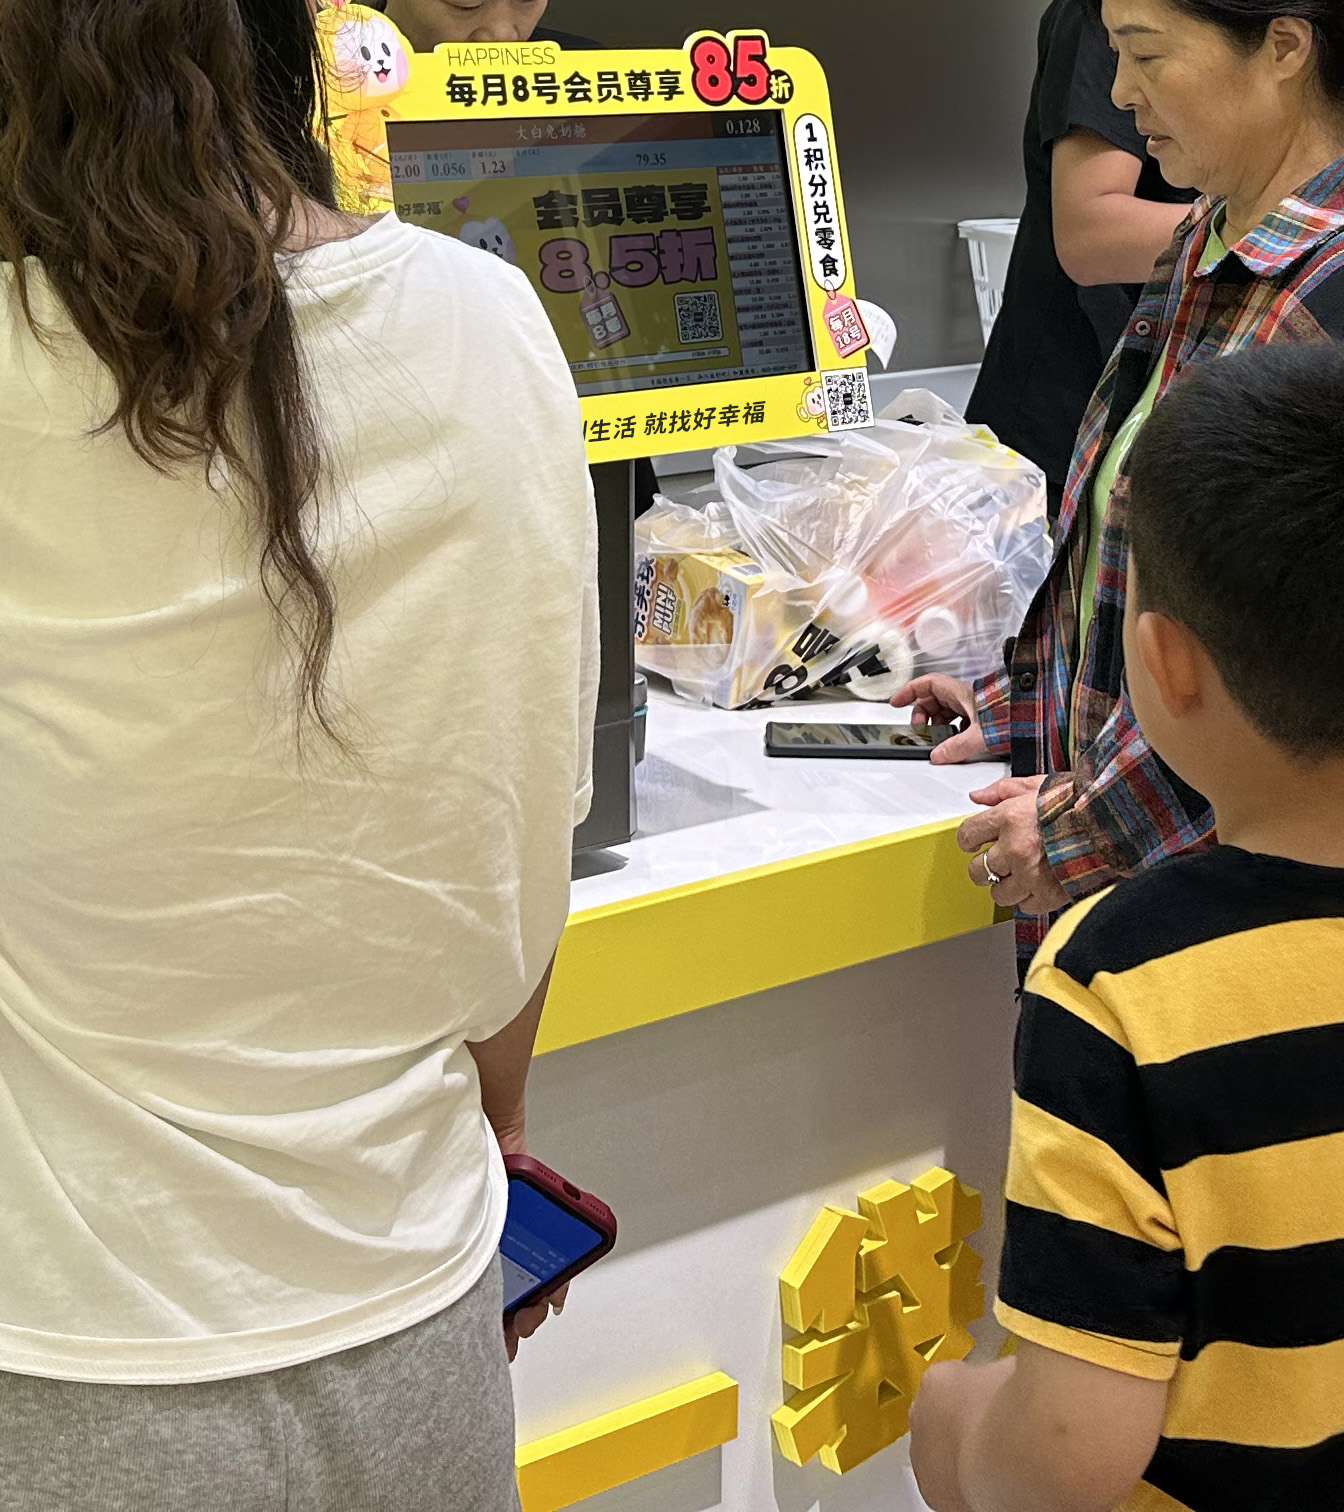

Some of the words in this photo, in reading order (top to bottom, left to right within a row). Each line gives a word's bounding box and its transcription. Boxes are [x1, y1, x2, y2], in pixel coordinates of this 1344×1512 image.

[446, 46, 556, 67] HAPPINESS
[516, 122, 587, 141] 大白兔奶糖
[725, 118, 761, 135] 0.128
[431, 162, 466, 177] 0.056
[481, 159, 506, 175] 1.23
[635, 153, 667, 167] 79.35
[532, 182, 712, 230] 会员尊享
[803, 122, 839, 278] 1积分兑零食
[538, 226, 718, 294] 8.5折
[828, 306, 857, 333] 每月
[834, 324, 862, 350] 18号
[582, 414, 637, 443] 生活
[643, 400, 766, 436] 就找好幸福
[653, 581, 670, 628] MINI
[660, 586, 677, 635] PUFF
